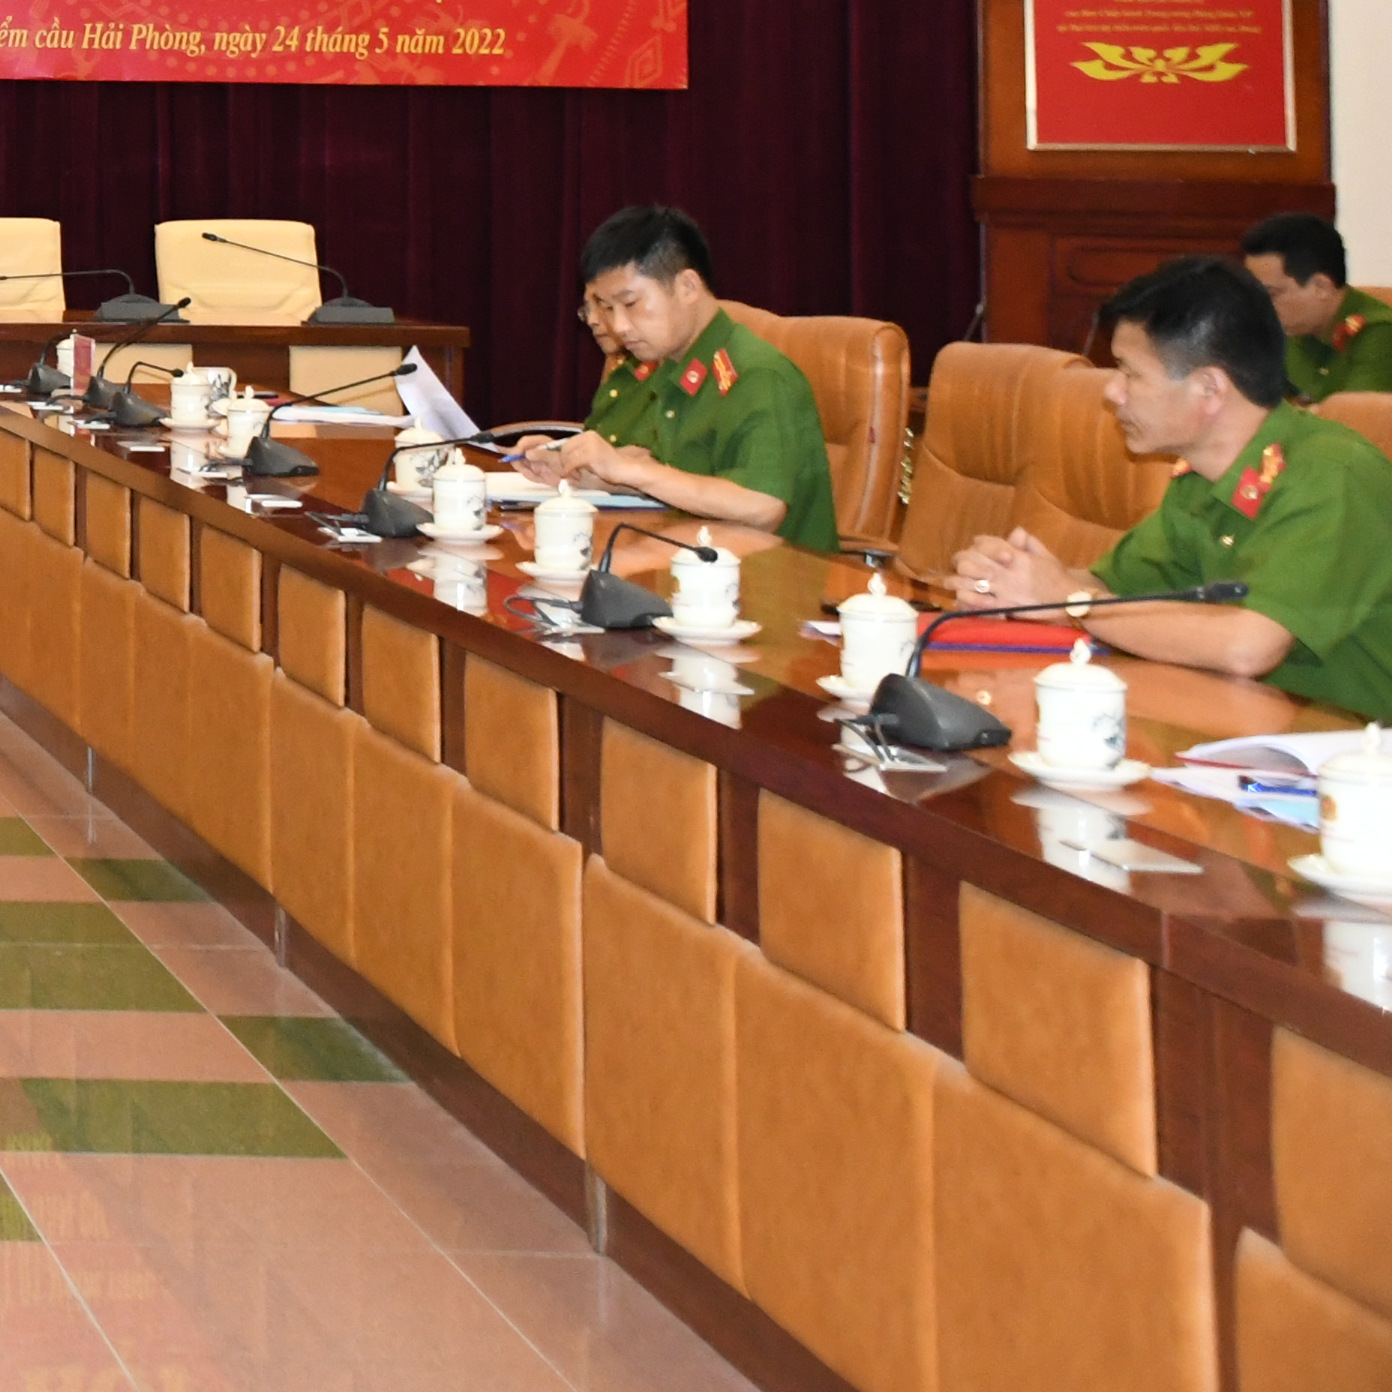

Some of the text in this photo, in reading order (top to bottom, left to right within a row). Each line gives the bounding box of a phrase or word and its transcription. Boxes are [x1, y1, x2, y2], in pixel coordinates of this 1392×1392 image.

[35, 17, 74, 49] cầu
[82, 21, 125, 50] Hải
[130, 23, 206, 57] Phòng,
[214, 28, 265, 57] ngày
[273, 26, 298, 52] 24
[304, 25, 369, 59] tháng
[375, 28, 389, 53] 5
[396, 28, 445, 53] năm
[451, 28, 505, 55] 2022
